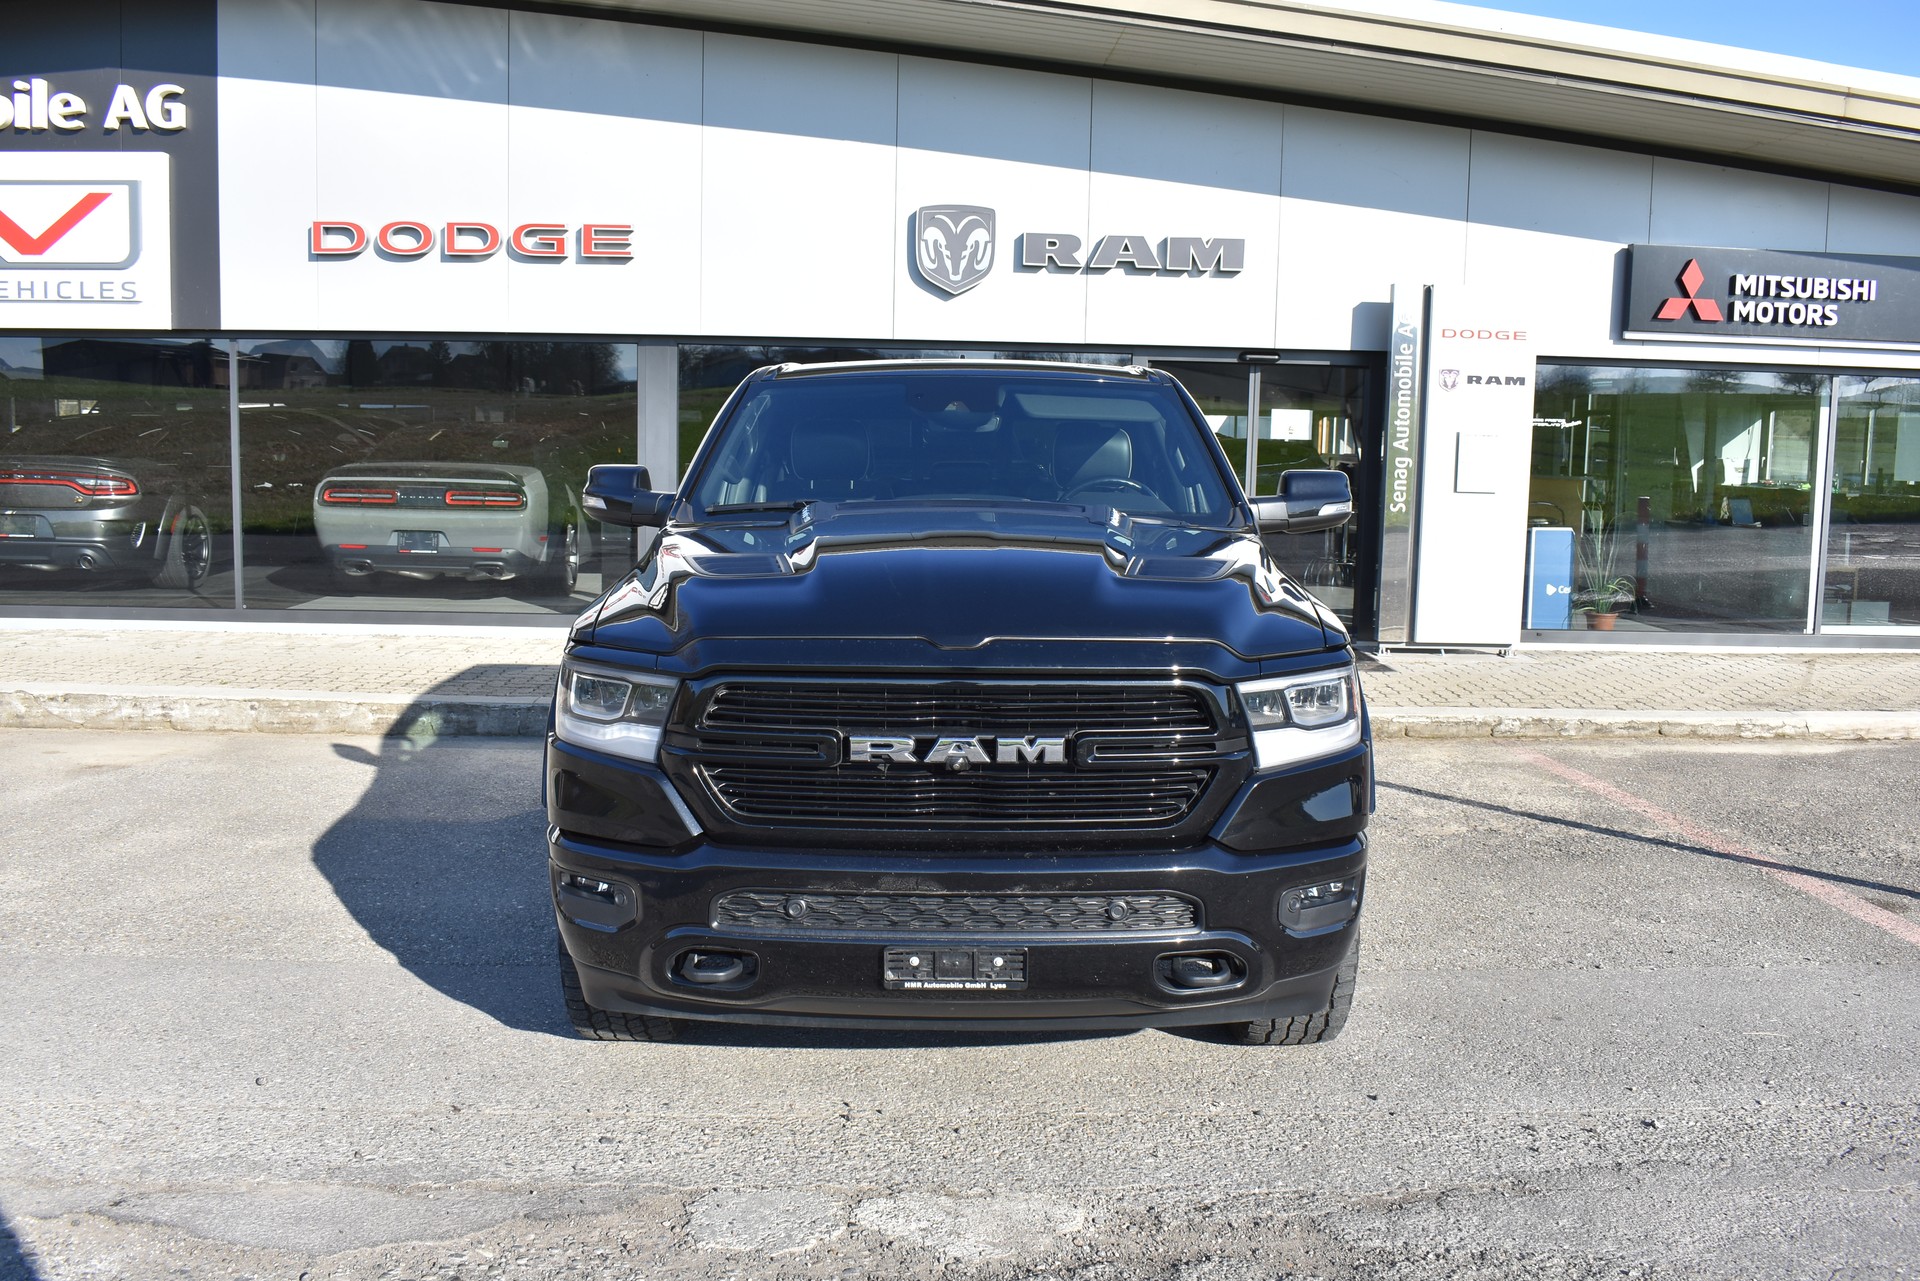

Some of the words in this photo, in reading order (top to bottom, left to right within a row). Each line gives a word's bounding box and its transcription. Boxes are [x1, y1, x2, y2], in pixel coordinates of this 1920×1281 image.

[103, 83, 188, 131] AG
[310, 220, 635, 259] DODGE
[1018, 231, 1246, 272] RAM
[1734, 272, 1878, 301] MITSUBISHI
[1732, 300, 1839, 326] MOTORS
[1441, 328, 1528, 341] DODGE
[1466, 374, 1526, 386] RAM
[1392, 343, 1414, 451] Automobile
[1389, 456, 1413, 514] Senag
[849, 735, 1067, 764] RAM
[923, 981, 964, 989] Automobile
[964, 981, 987, 989] GmbH
